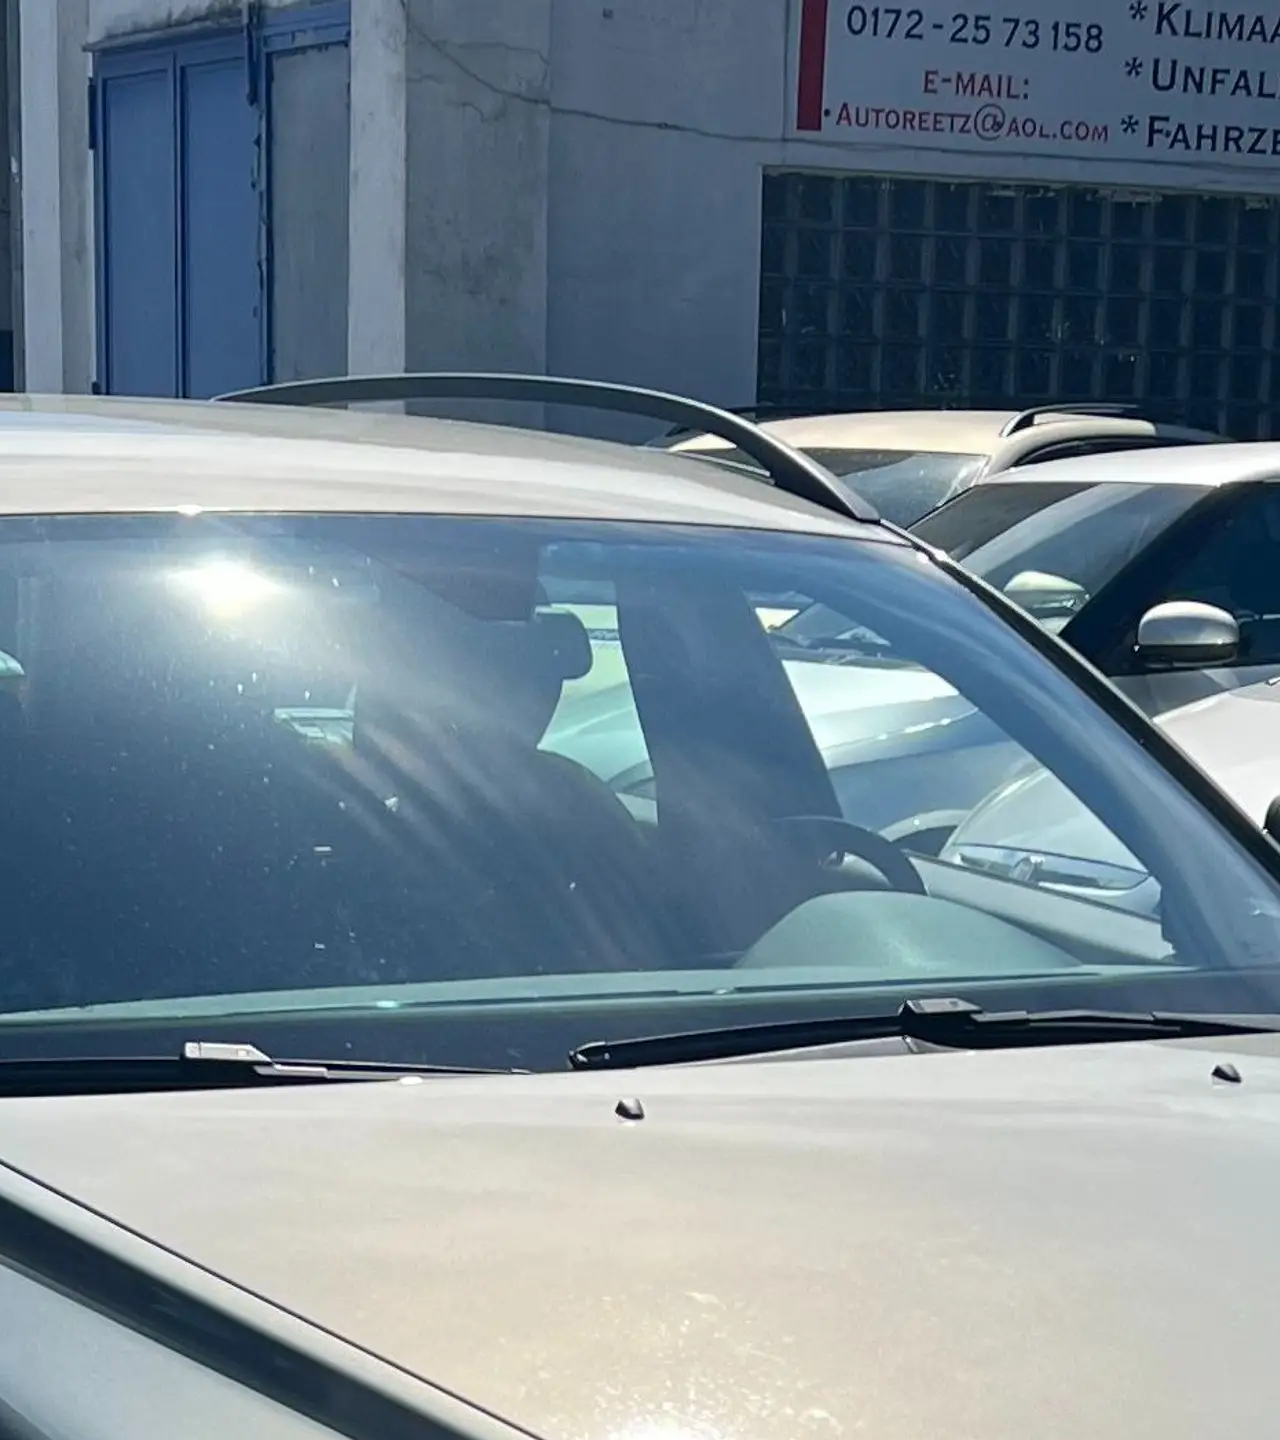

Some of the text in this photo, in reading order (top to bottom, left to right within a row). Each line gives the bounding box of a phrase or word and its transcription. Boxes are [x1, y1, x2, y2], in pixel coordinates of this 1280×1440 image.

[1002, 17, 1041, 50] 73
[1051, 21, 1104, 53] 158
[923, 70, 1030, 101] E-MAIL:
